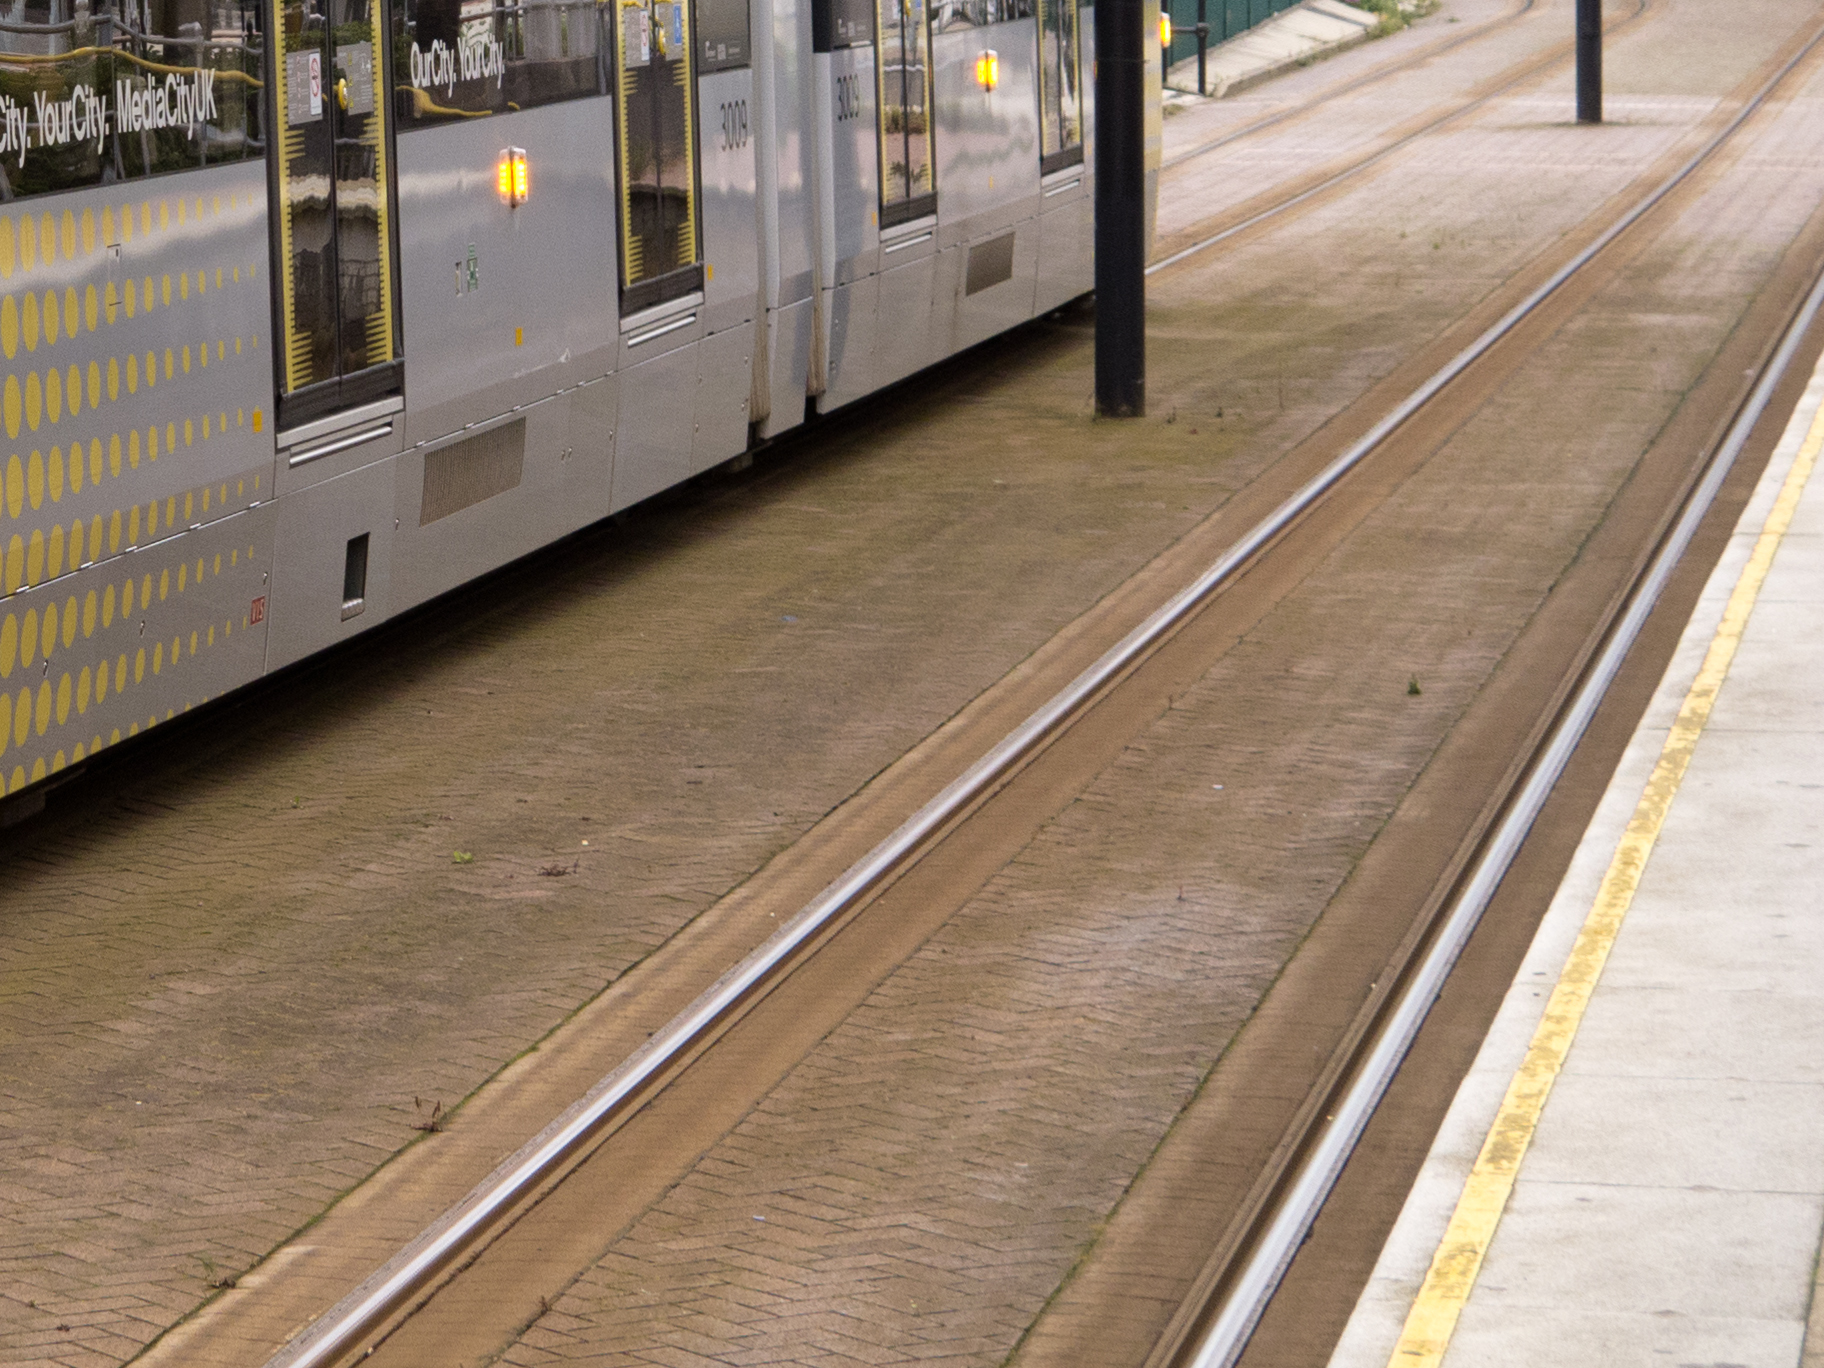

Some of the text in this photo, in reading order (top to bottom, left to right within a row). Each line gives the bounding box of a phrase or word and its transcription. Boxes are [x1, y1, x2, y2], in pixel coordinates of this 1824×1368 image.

[410, 38, 457, 99] OurCity.
[33, 83, 111, 155] YourCity.
[116, 68, 218, 141] MediaCityUK
[720, 99, 748, 151] 3009
